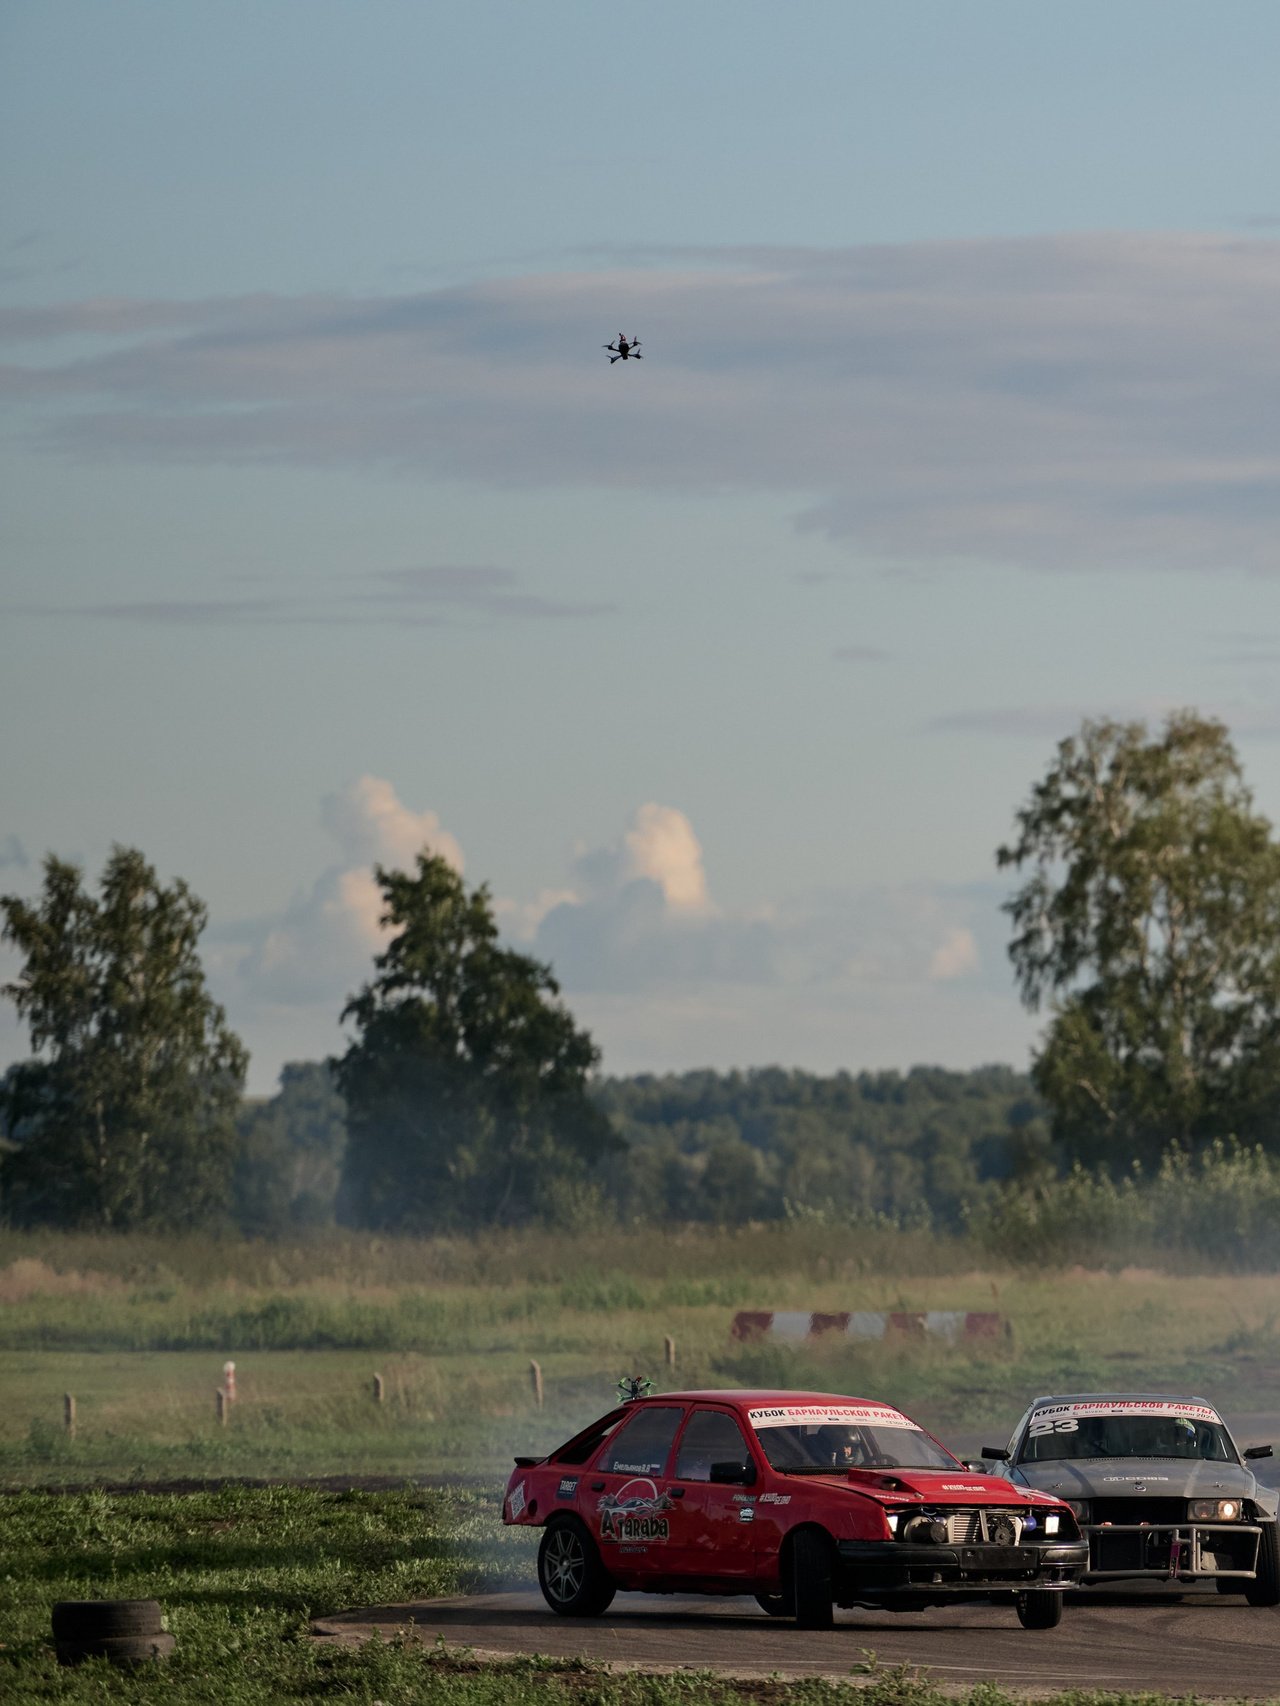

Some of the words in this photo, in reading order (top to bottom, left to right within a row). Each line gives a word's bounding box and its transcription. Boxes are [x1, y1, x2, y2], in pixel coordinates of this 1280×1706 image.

[750, 1409, 786, 1419] КУБОК
[787, 1408, 871, 1417] БАРНАУЛЬСКОЙ
[1034, 1405, 1071, 1417] КУБОК
[1073, 1401, 1164, 1411] БАРНАУЛЬСКОЙ
[1166, 1403, 1213, 1415] РАКЕТЫ
[1029, 1418, 1079, 1438] 23
